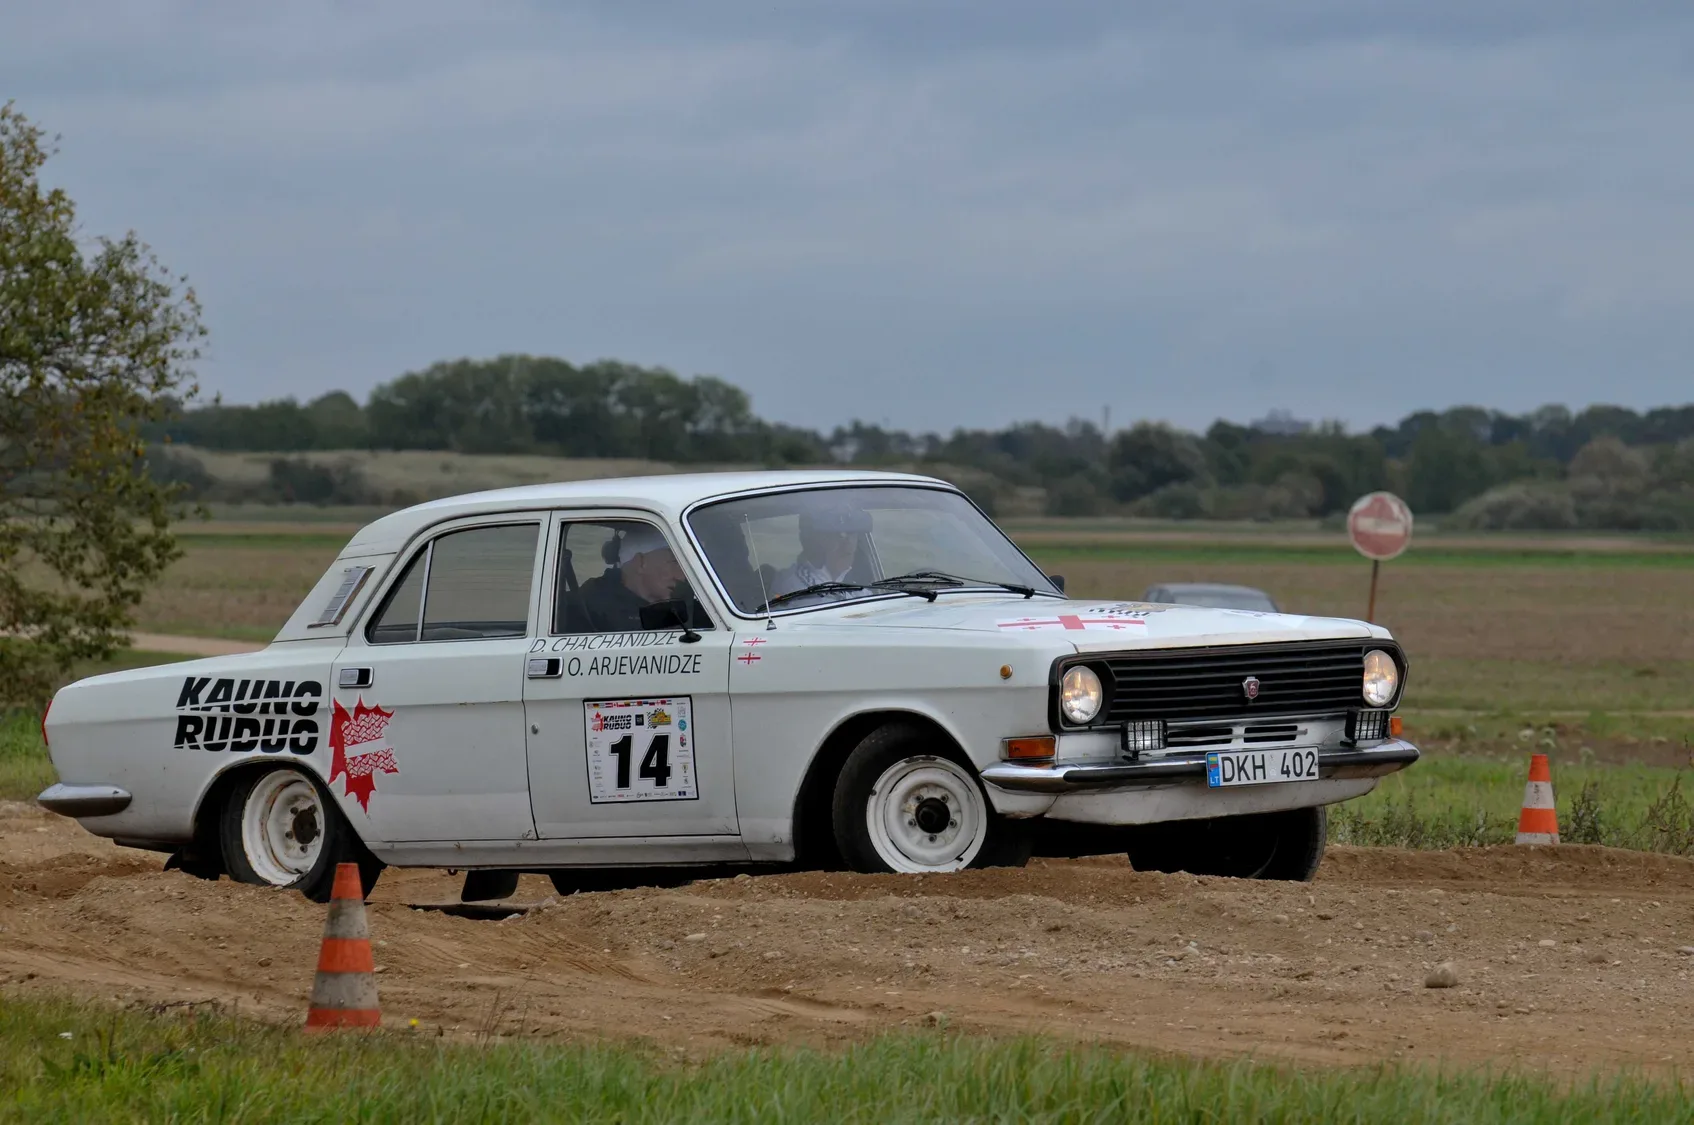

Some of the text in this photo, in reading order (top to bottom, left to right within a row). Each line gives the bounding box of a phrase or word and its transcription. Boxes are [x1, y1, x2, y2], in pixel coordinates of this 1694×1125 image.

[530, 632, 678, 654] D. CHACHANIDZE
[567, 654, 703, 677] O. ARJEVANIDZE
[176, 677, 322, 716] KAUNO
[603, 714, 632, 722] KAUNO
[603, 722, 632, 730] RUDUO
[174, 715, 318, 755] RUDUO
[609, 733, 672, 790] 14
[1221, 751, 1316, 783] DKH 402
[1210, 776, 1219, 784] LT
